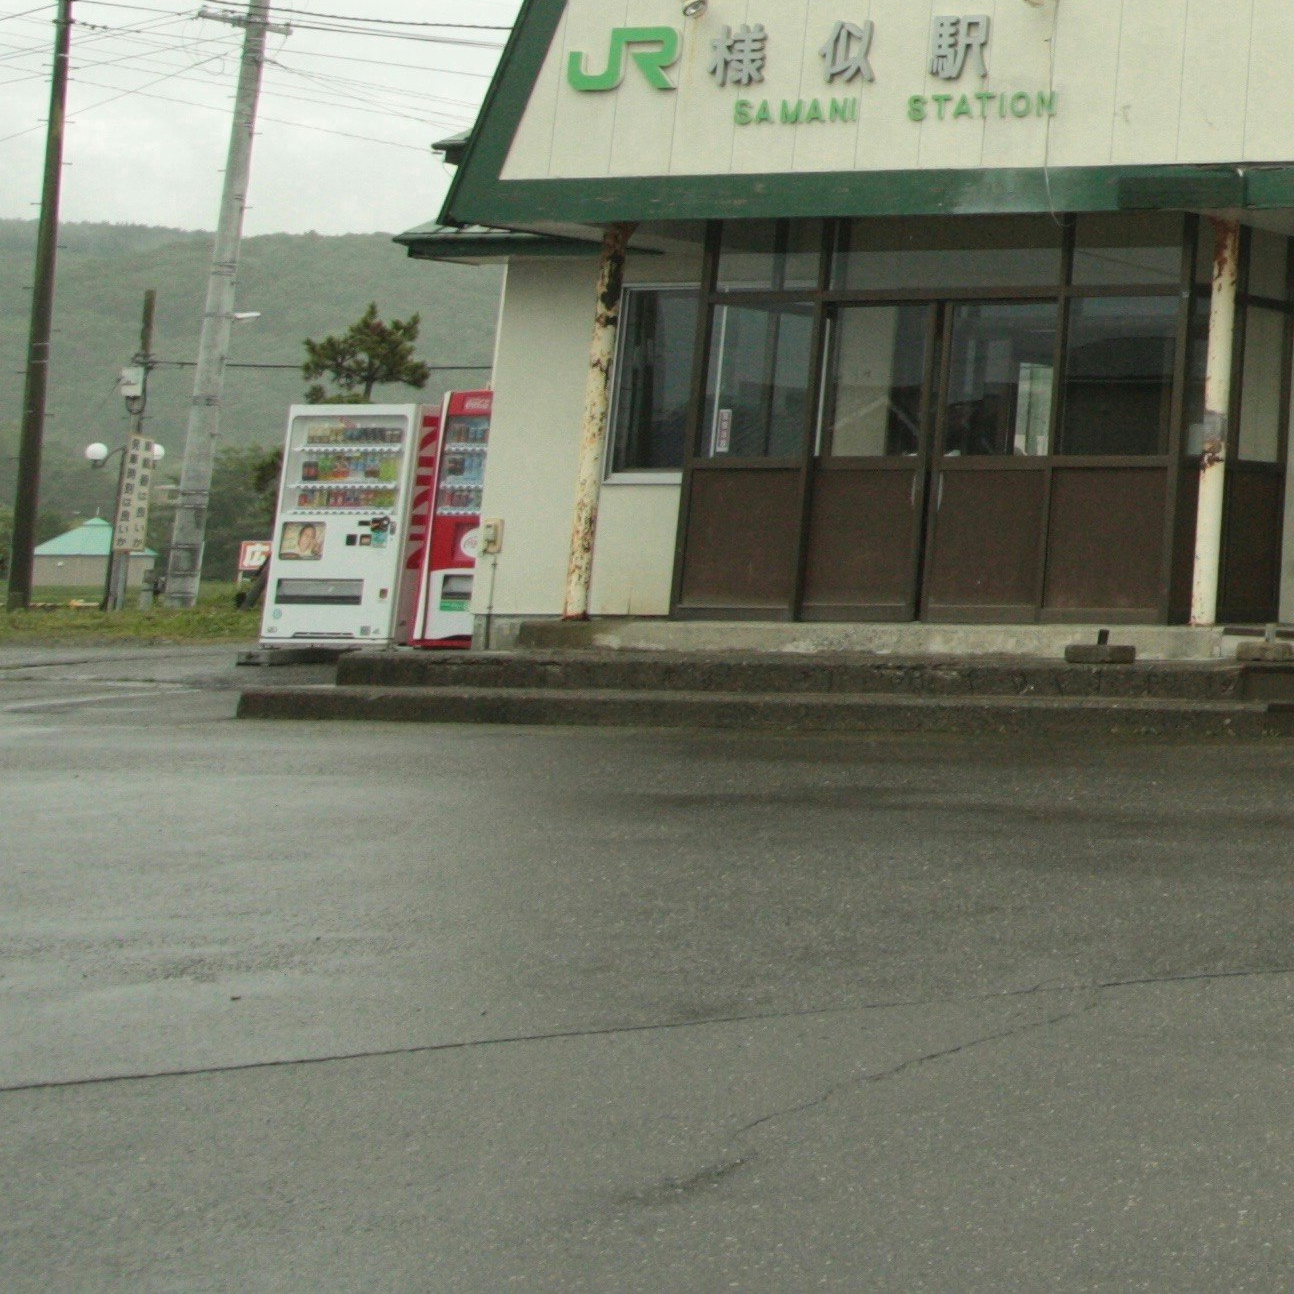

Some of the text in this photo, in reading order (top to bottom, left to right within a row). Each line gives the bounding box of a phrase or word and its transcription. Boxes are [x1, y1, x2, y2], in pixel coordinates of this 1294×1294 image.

[567, 27, 679, 91] JR
[708, 14, 990, 86] 様似駅
[733, 90, 1057, 125] SAMANI STATION
